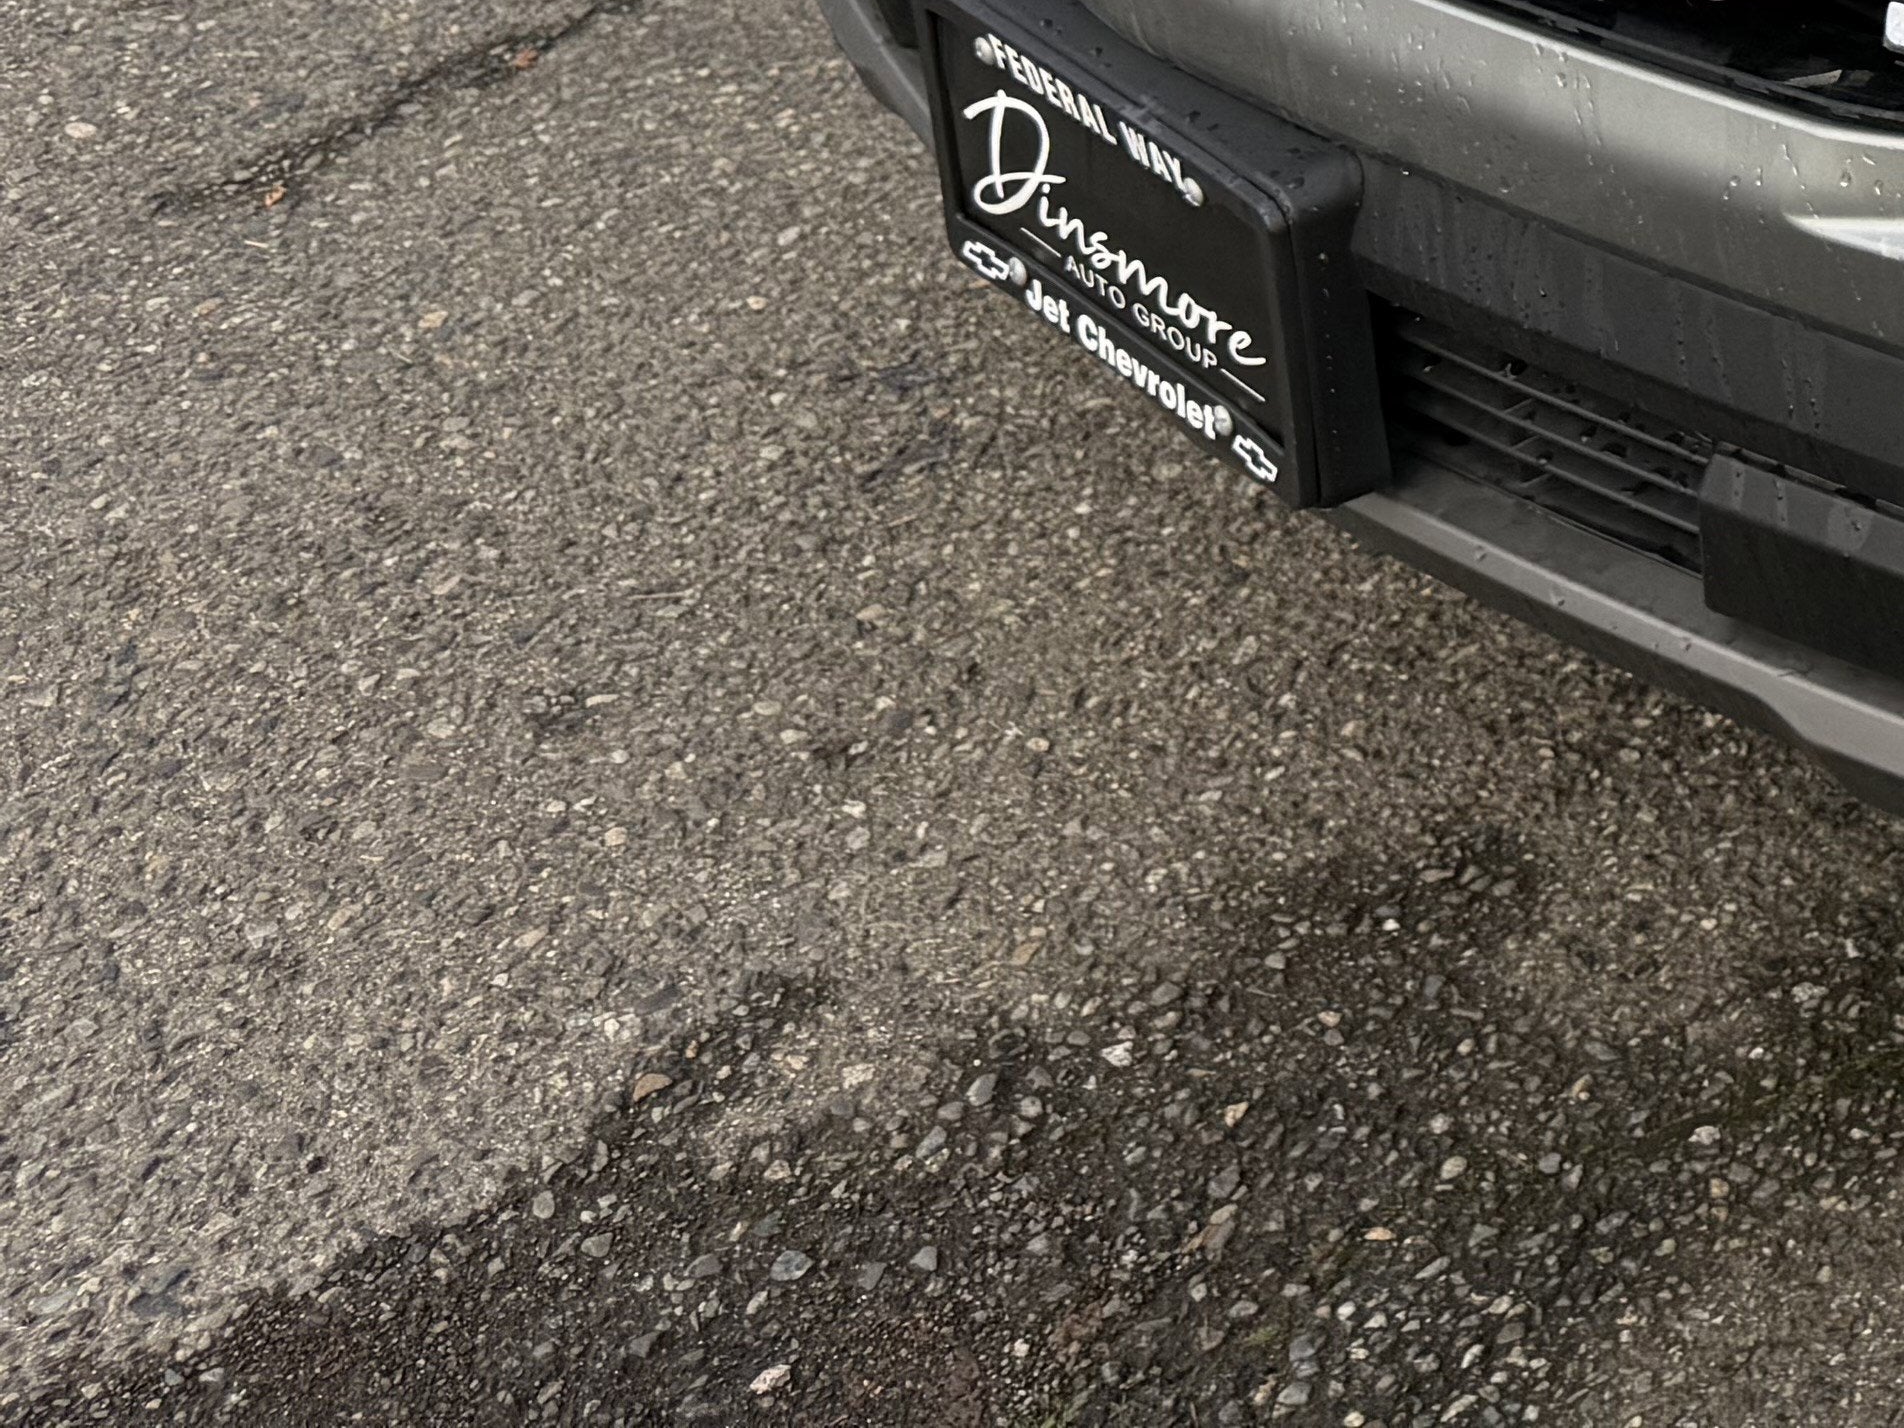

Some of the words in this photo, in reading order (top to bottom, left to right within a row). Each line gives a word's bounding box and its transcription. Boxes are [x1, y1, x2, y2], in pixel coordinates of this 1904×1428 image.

[987, 33, 1118, 145] FEDERAL
[1118, 121, 1186, 192] WAY
[963, 88, 1267, 366] Dinsmore
[1025, 279, 1071, 334] Jet
[1076, 314, 1219, 440] Chevrolet
[1064, 255, 1127, 309] AUTO
[1132, 302, 1219, 370] GROUP
